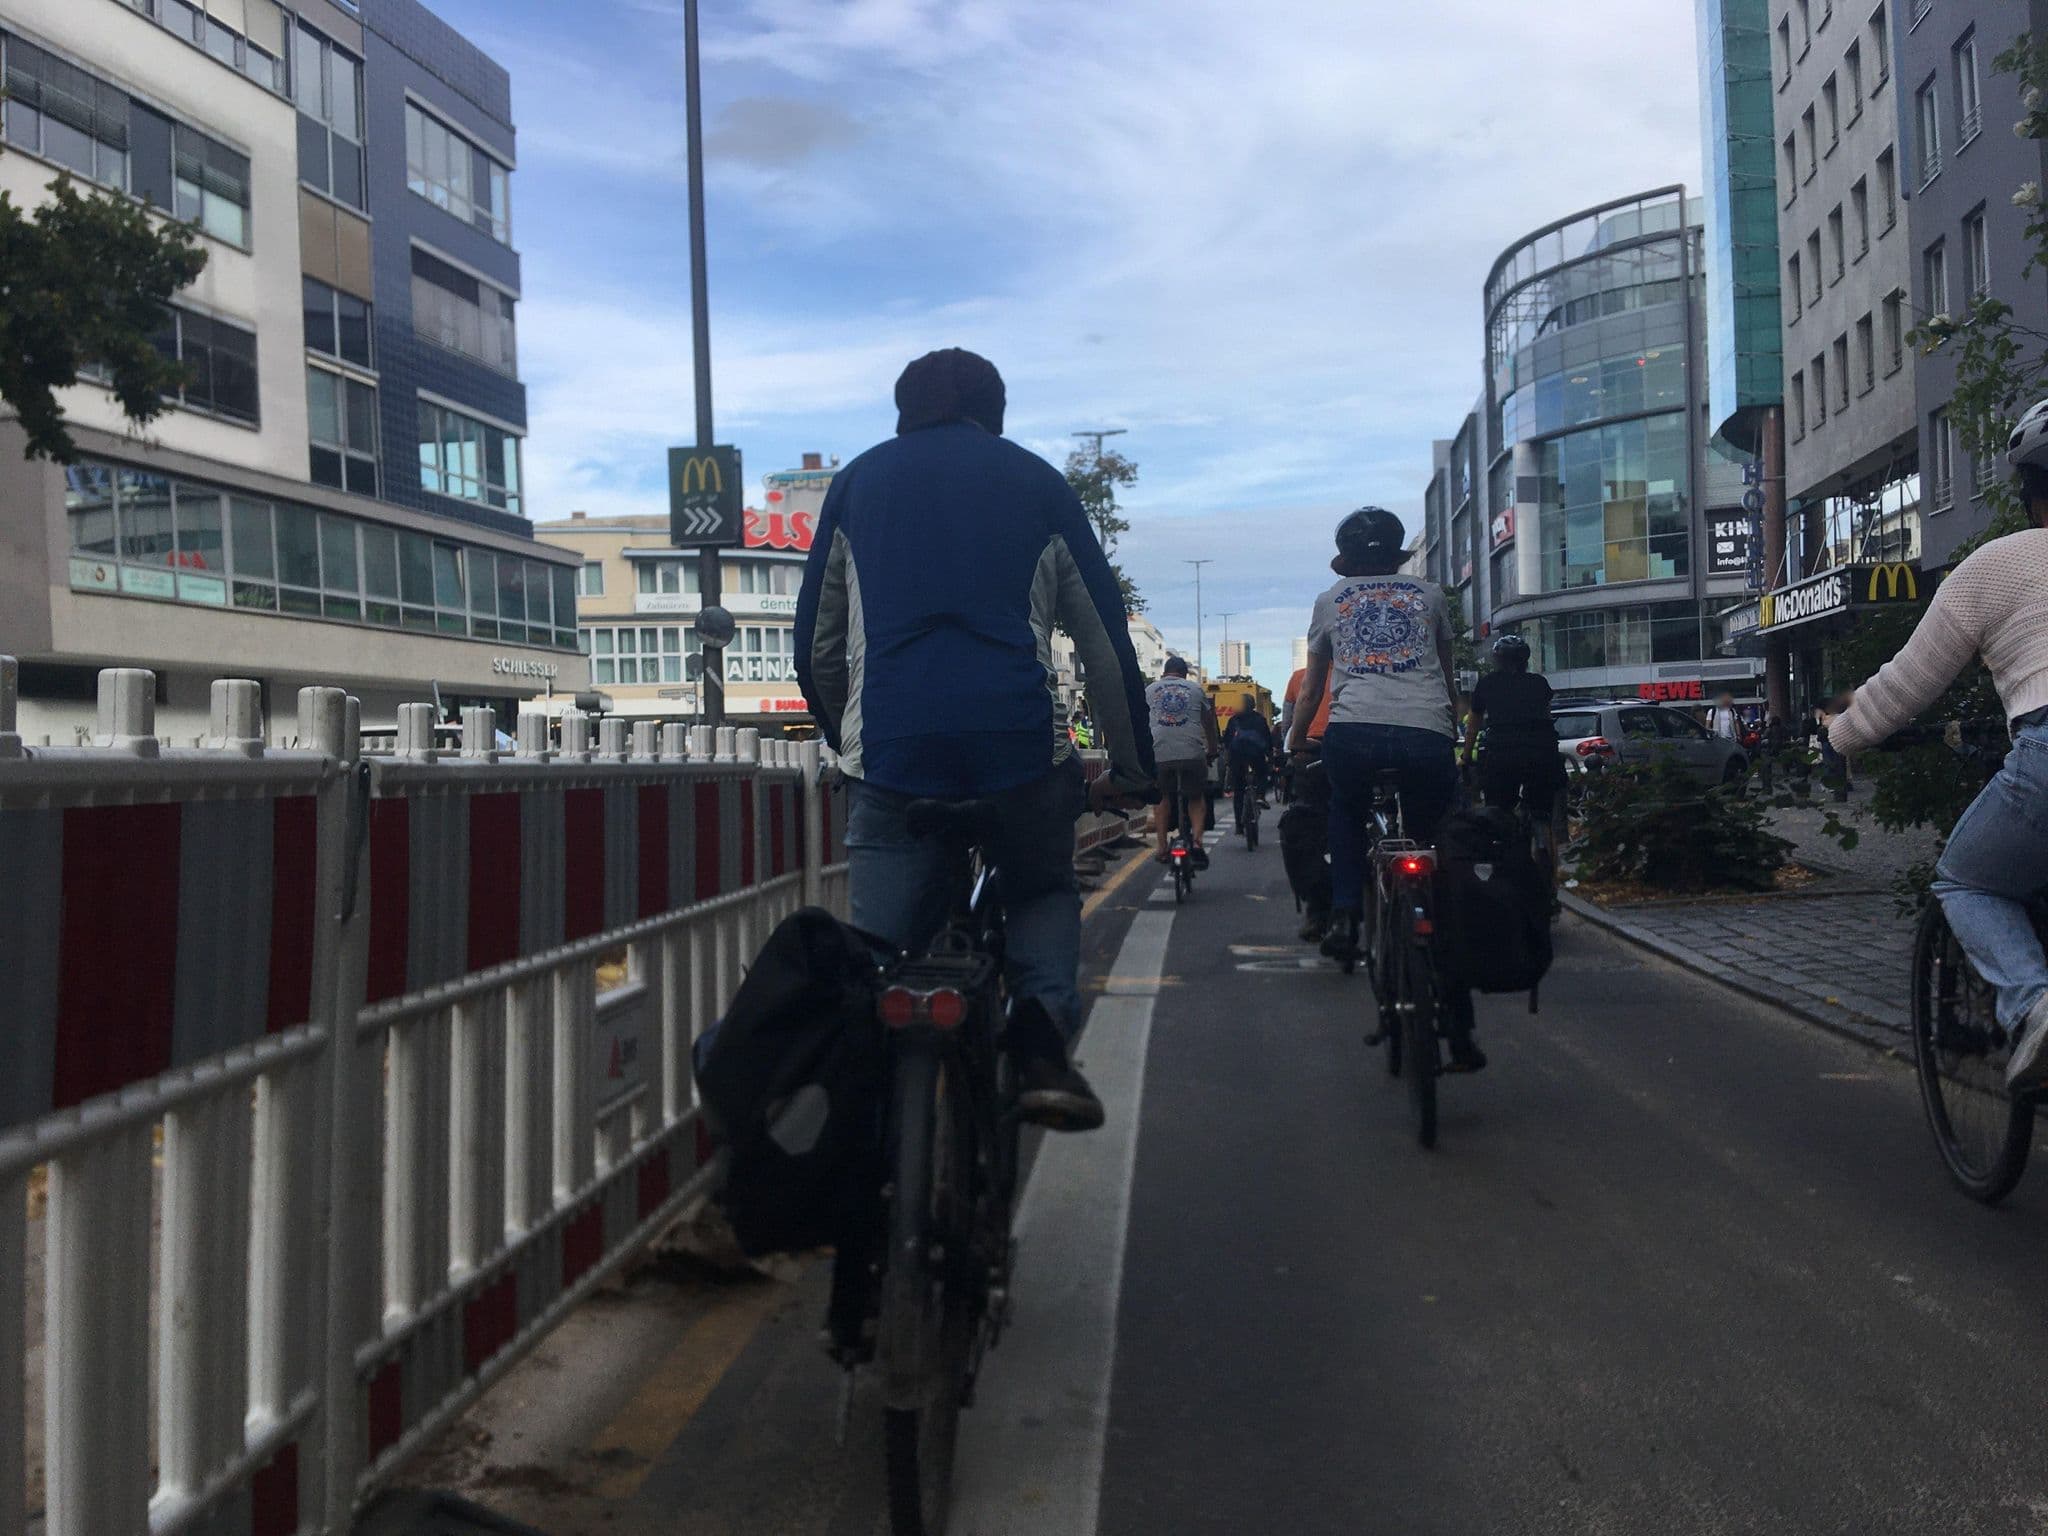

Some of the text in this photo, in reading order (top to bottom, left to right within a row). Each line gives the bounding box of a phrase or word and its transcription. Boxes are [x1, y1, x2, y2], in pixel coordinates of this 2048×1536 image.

[1334, 587, 1356, 604] DIE
[1774, 576, 1842, 625] McDonald's
[493, 657, 559, 678] SCHIESSER
[1639, 681, 1702, 701] REWE
